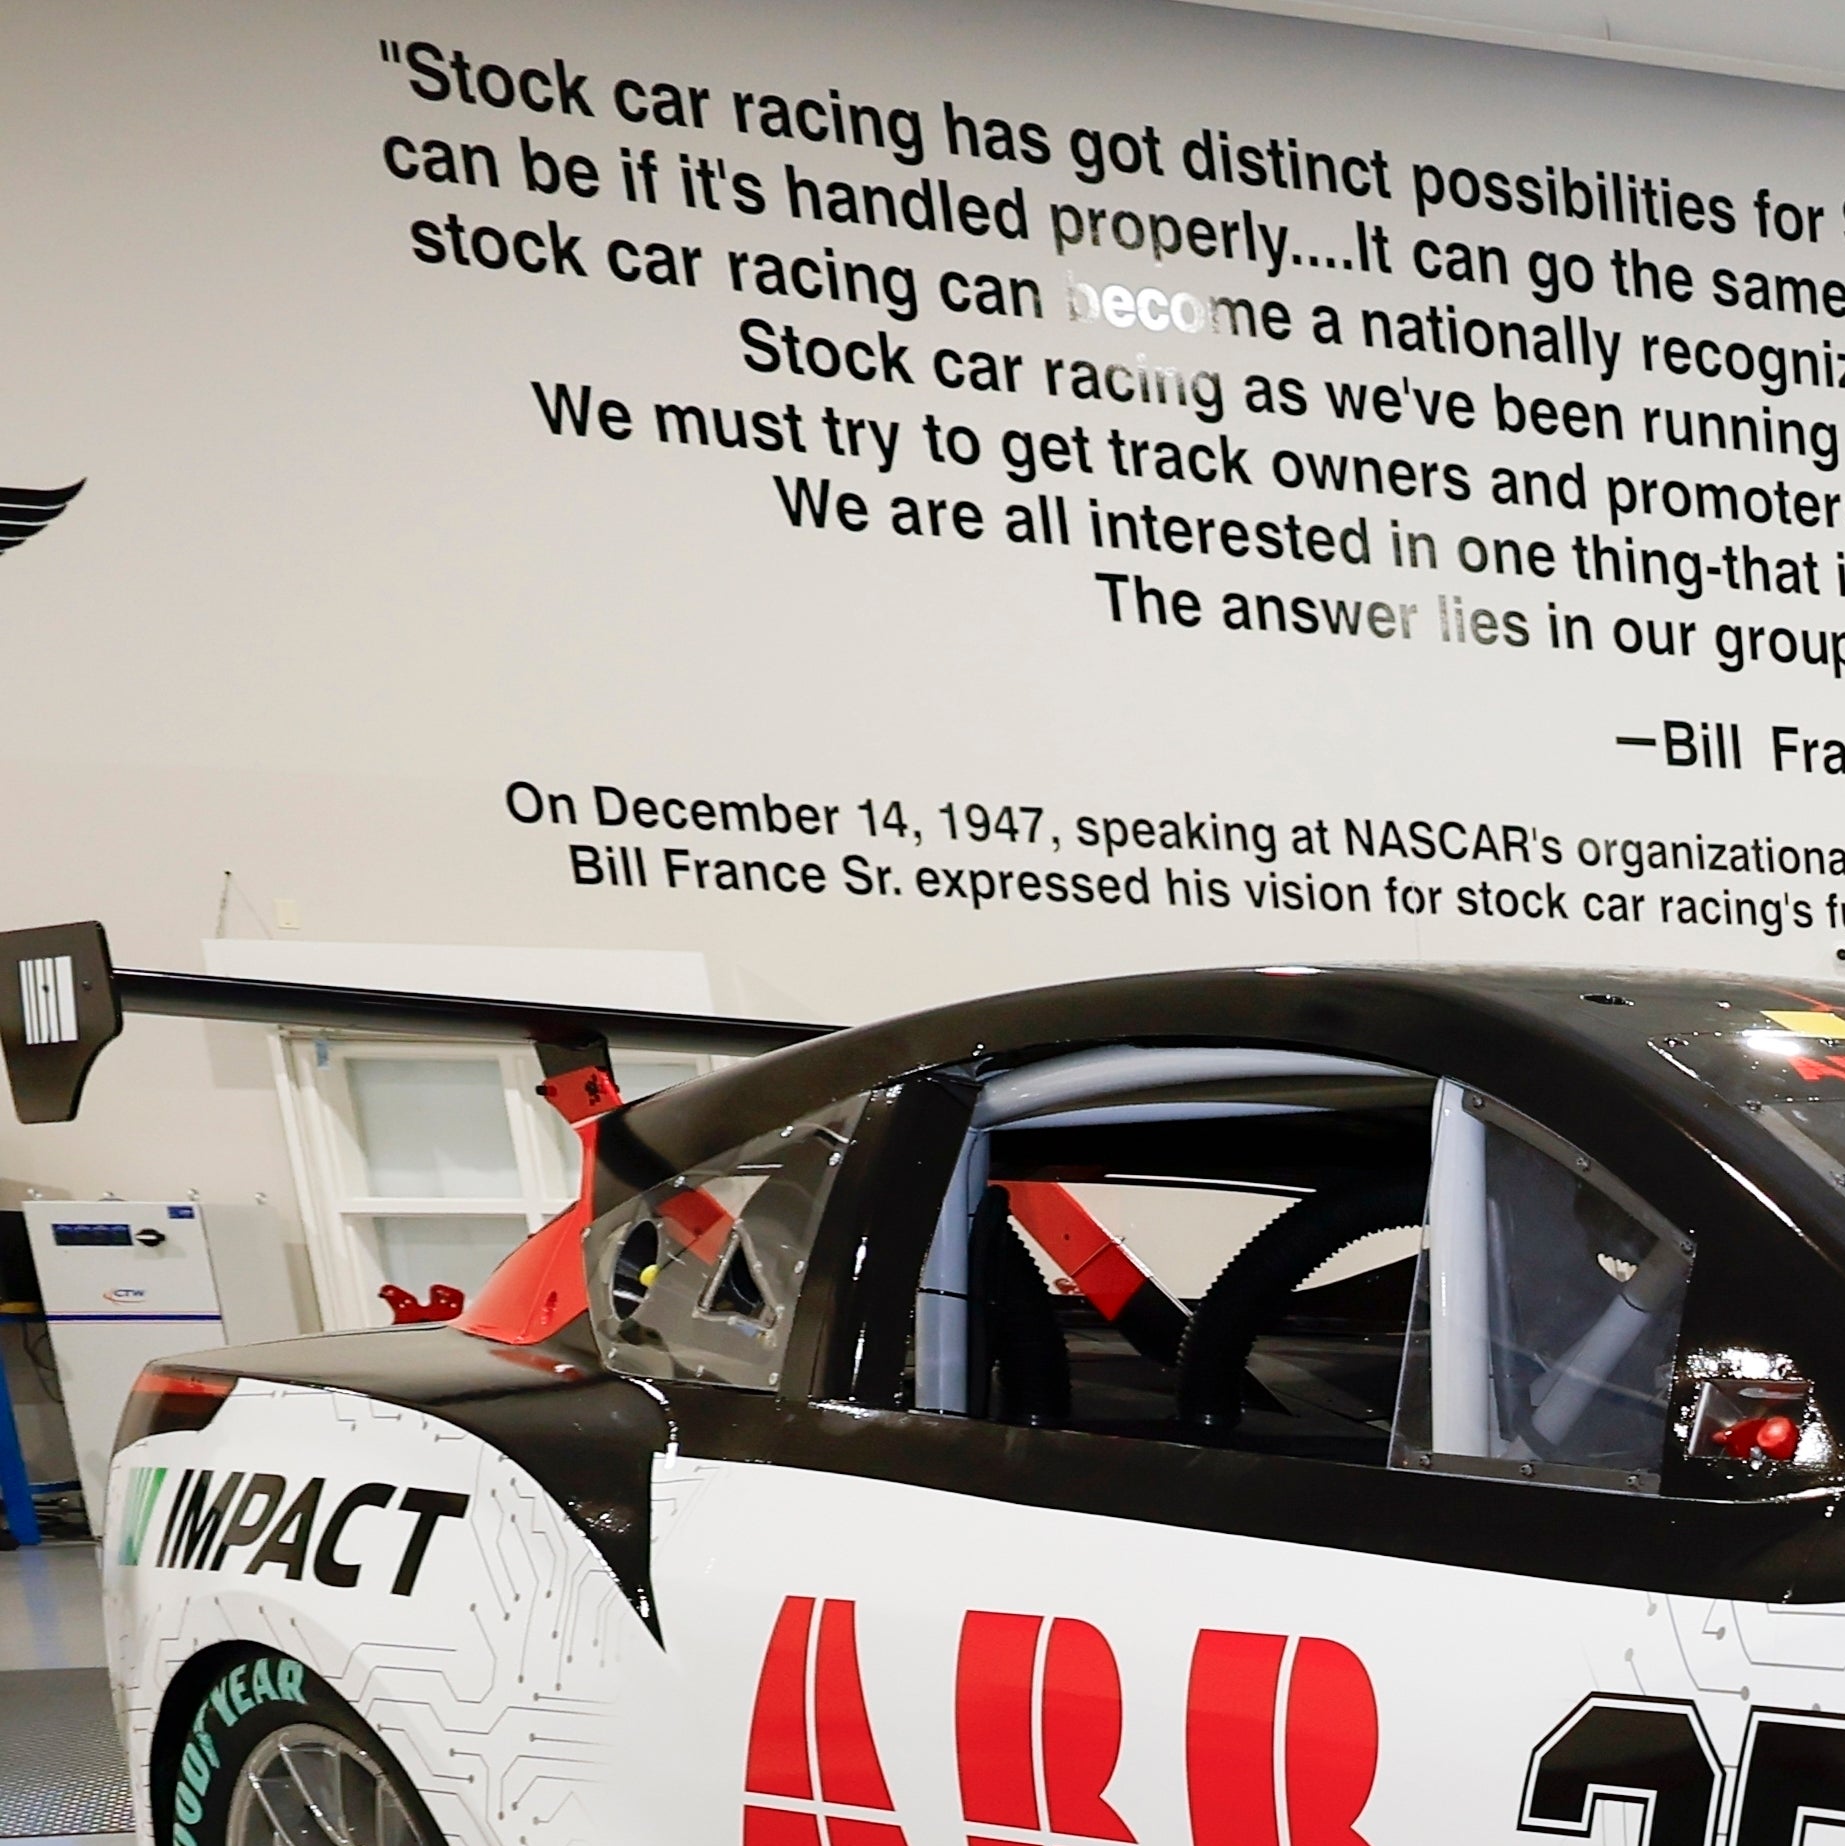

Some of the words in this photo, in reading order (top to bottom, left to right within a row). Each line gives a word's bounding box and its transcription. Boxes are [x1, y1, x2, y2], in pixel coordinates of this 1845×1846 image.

[382, 135, 501, 189] can
[518, 135, 601, 199] be
[619, 146, 659, 205] if
[678, 152, 767, 216] it's
[783, 163, 1030, 241] handled
[1412, 238, 1510, 286] can
[1527, 250, 1595, 305] go
[1609, 247, 1694, 304] the
[612, 78, 711, 130] car
[732, 88, 925, 167] racing
[942, 100, 1052, 166] has
[1069, 125, 1166, 185] got
[1182, 127, 1393, 200] distinct
[1411, 163, 1737, 235] possibilities
[1752, 187, 1825, 244] for
[409, 212, 589, 278] stock
[606, 238, 703, 288] car
[727, 246, 919, 323] racing
[938, 270, 1044, 320] can
[1311, 304, 1344, 346] a
[1360, 303, 1622, 382] nationally
[529, 380, 634, 441] We
[653, 403, 808, 454] must
[820, 406, 901, 474] try
[921, 413, 982, 467] to
[1000, 425, 1095, 484] get
[1106, 428, 1254, 486] track
[1271, 449, 1472, 502] owners
[1490, 461, 1588, 511] and
[739, 317, 916, 385] Stock
[932, 348, 1024, 393] car
[1243, 374, 1309, 417] as
[1323, 375, 1476, 430] we've
[1493, 381, 1625, 441] been
[1642, 404, 1840, 473] running
[771, 474, 870, 533] We
[889, 495, 985, 541] are
[1004, 493, 1071, 546] all
[1088, 497, 1372, 566] interested
[1456, 535, 1556, 579] one
[1093, 571, 1203, 629] The
[1547, 601, 1594, 651] in
[1612, 616, 1698, 657] our
[505, 780, 578, 826] On
[592, 784, 841, 836] December
[856, 797, 923, 848] 14,
[938, 801, 1061, 854] 1947,
[1075, 810, 1278, 864] speaking
[1290, 818, 1332, 856] at
[1343, 817, 1564, 866] NASCAR's
[567, 843, 649, 888] Bill
[662, 847, 827, 895] France
[841, 853, 903, 897] Sr.
[914, 865, 1151, 911] expressed
[1164, 866, 1232, 909] his
[1242, 870, 1372, 913] vision
[1383, 875, 1443, 916] for
[1456, 880, 1570, 920] stock
[1582, 891, 1646, 923] car
[1659, 887, 1814, 938] racing's
[155, 1468, 471, 1597] IMPACT
